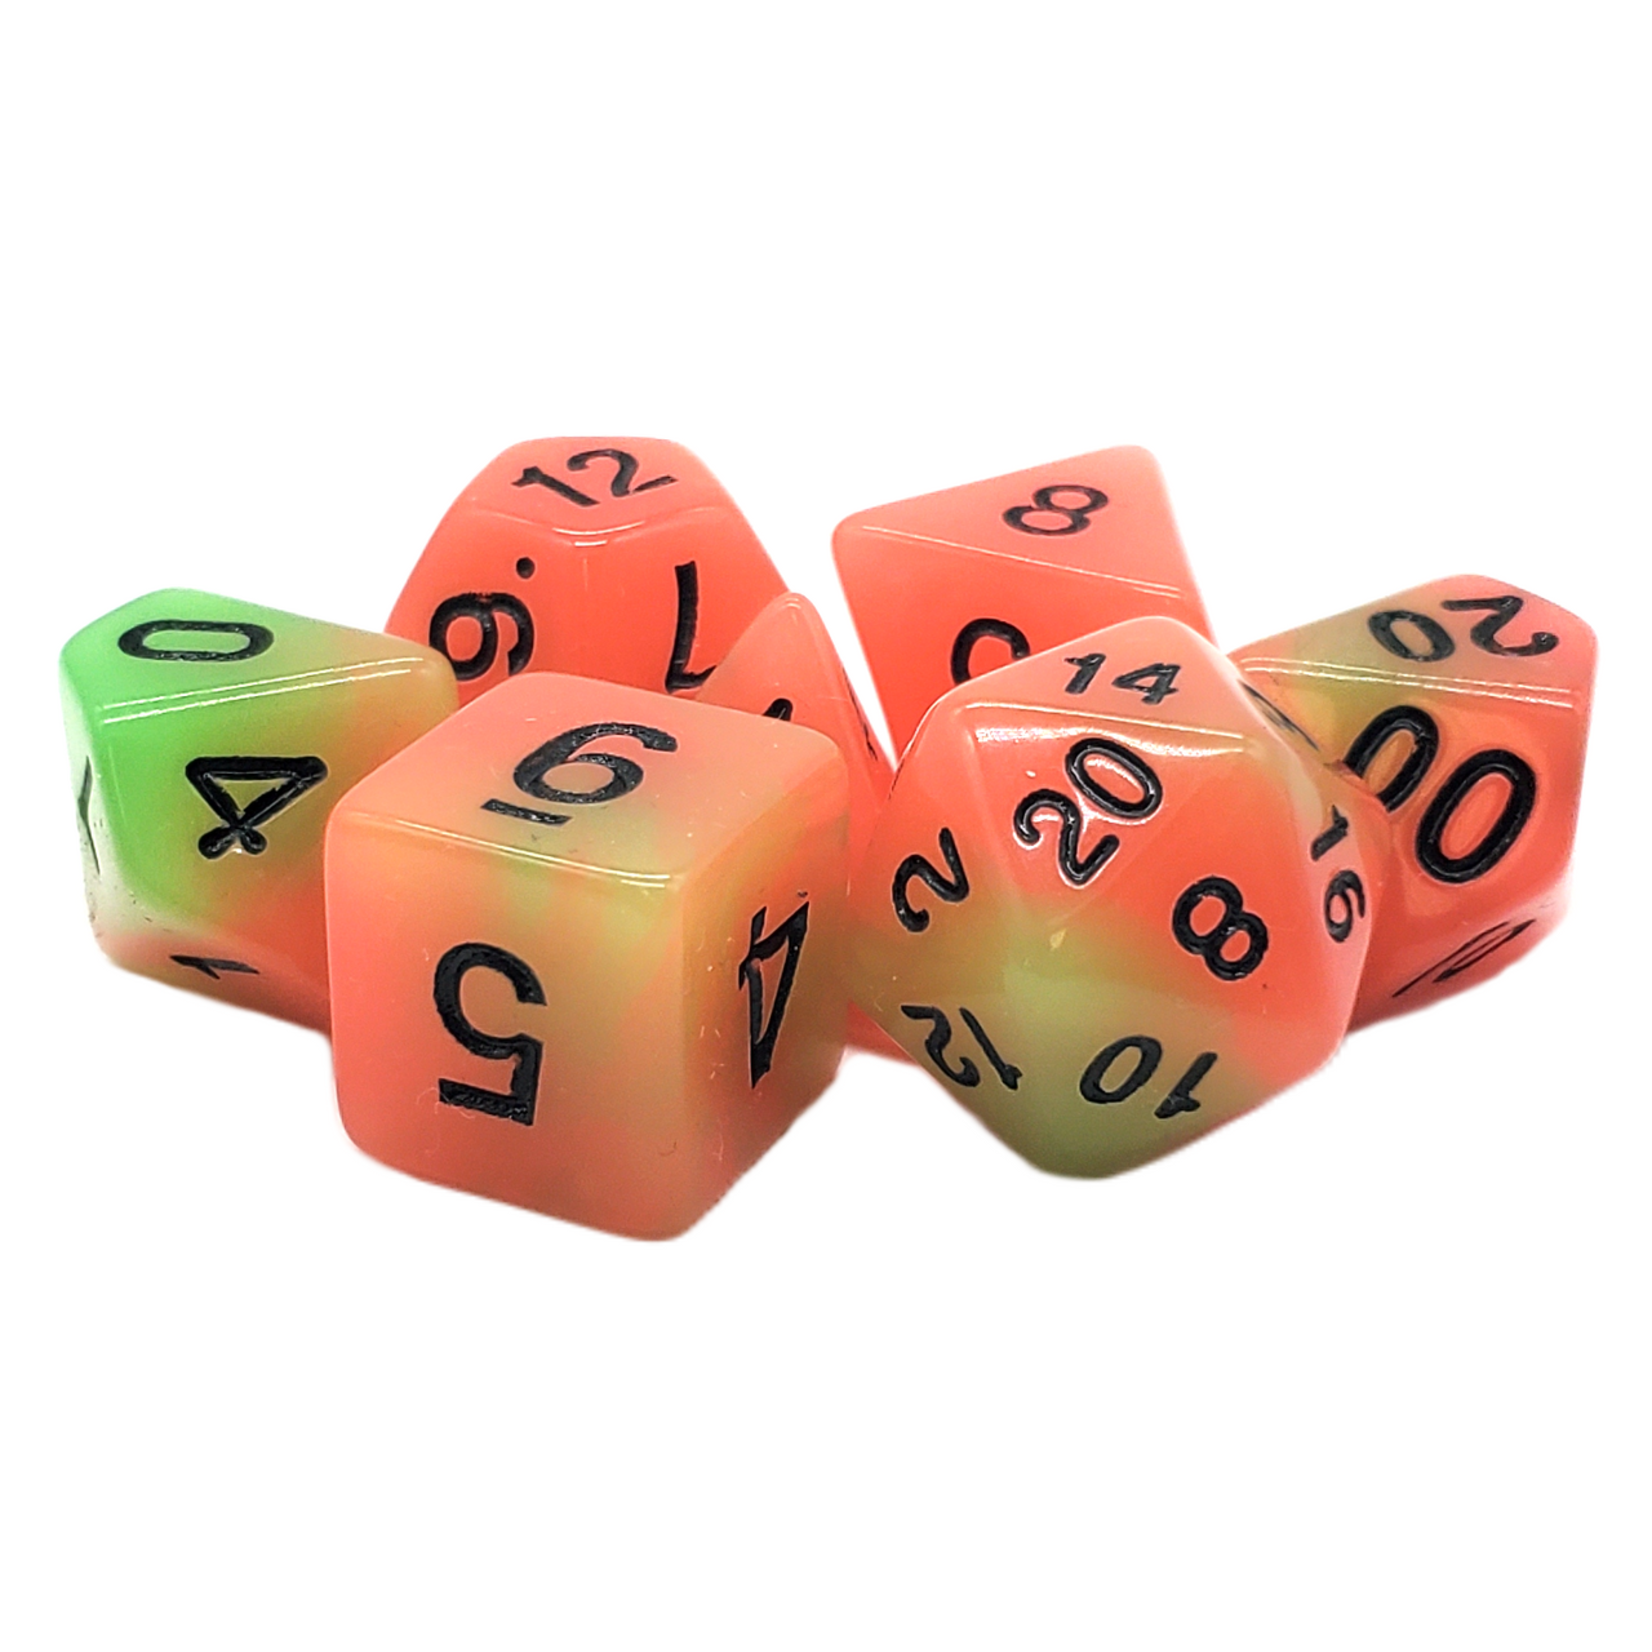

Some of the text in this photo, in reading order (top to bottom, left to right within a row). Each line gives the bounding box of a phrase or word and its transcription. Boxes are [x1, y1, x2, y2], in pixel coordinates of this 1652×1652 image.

[511, 448, 679, 507] 12
[1002, 484, 1109, 535] 8
[117, 618, 274, 662] 0
[1064, 652, 1182, 704] 14
[1367, 595, 1559, 662] 20
[184, 755, 329, 860] 4
[1013, 737, 1164, 886] 20
[1342, 704, 1537, 884] 00
[891, 827, 970, 933] 2
[1310, 804, 1366, 943] 16
[1172, 876, 1269, 981] 8
[432, 942, 548, 1127] 5
[738, 901, 810, 1090] 4
[900, 1004, 1023, 1092] 12
[1078, 1035, 1218, 1120] 10
